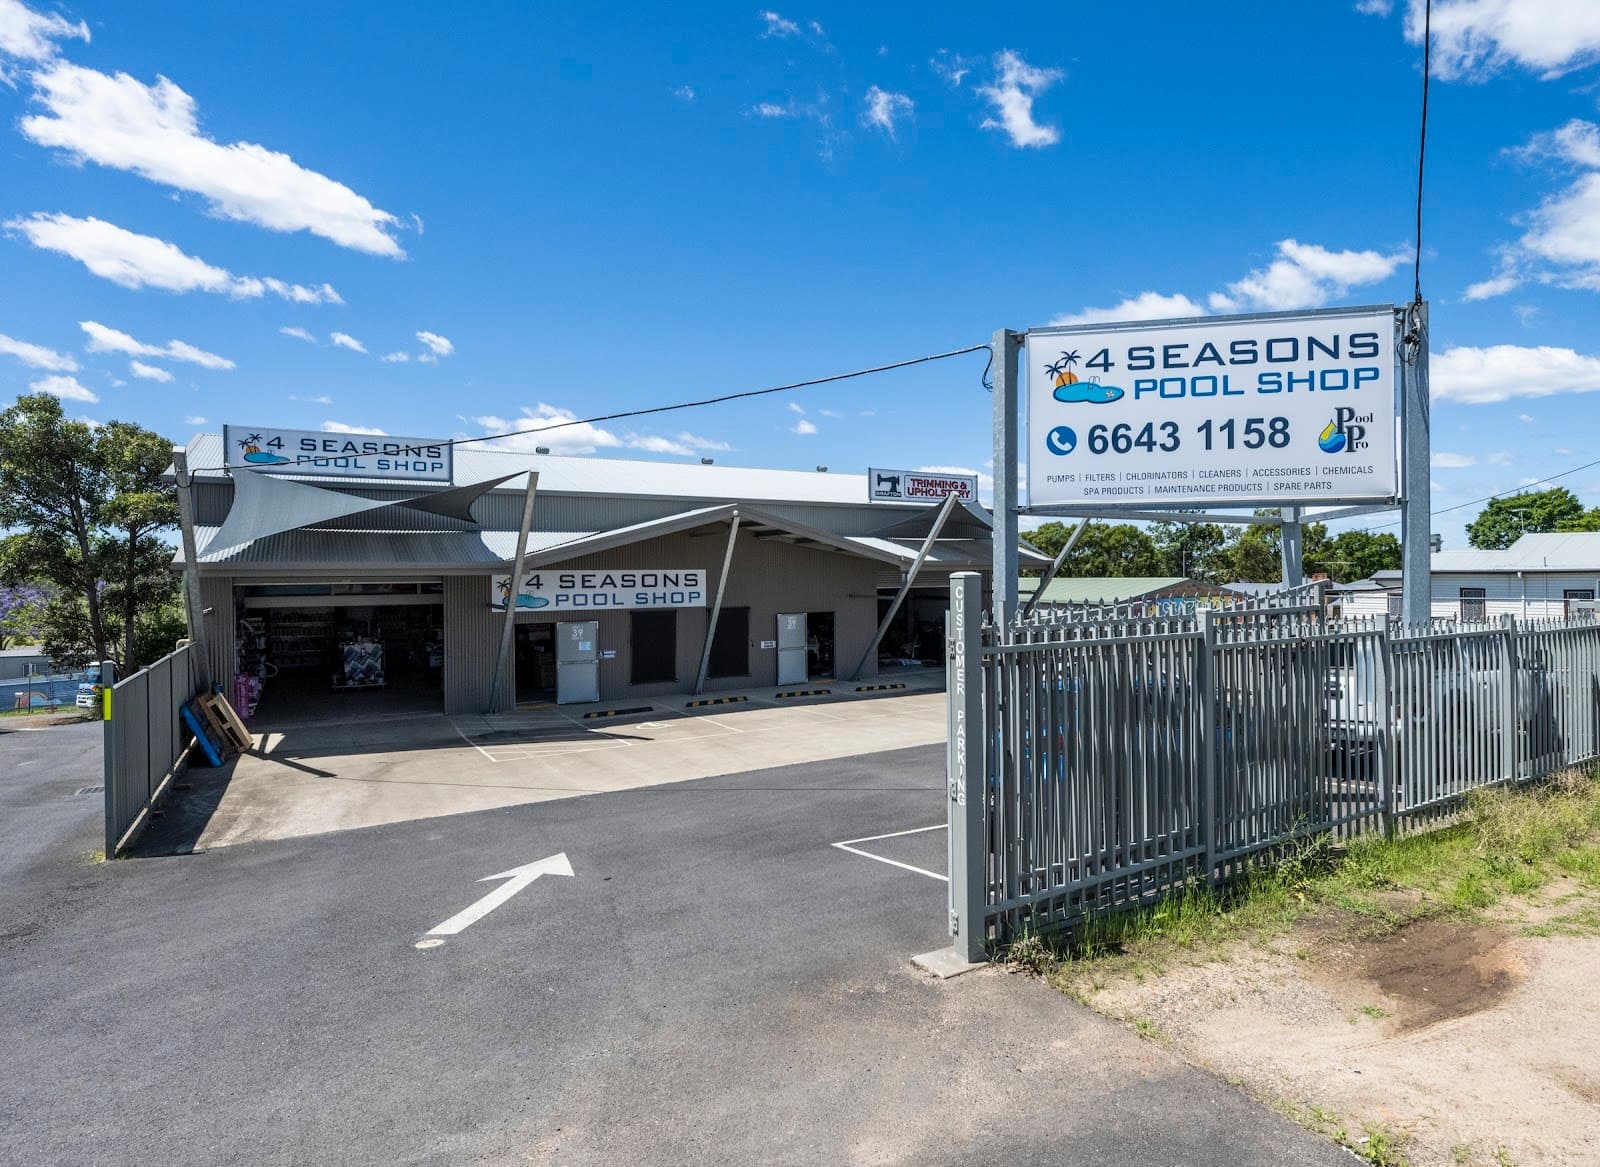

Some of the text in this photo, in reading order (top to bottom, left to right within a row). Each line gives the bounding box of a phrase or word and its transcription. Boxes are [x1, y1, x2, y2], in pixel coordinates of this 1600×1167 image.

[1085, 332, 1379, 373] 4 SEASONS
[1134, 366, 1380, 400] POOL SHOP
[1334, 407, 1373, 434] Pool
[266, 436, 441, 459] 4 SEASONS
[1087, 416, 1291, 455] 6643 1158
[1344, 425, 1369, 452] Pro
[297, 455, 443, 473] POOL SHOP
[1047, 465, 1374, 483] PUMPS FILTERS CHLORINATORS CLEANERS ACCESSORIES CHEMICALS
[911, 478, 959, 489] TRIMMING
[1083, 480, 1333, 496] SPA PRODUCTS MAINTENANCE PRODUCTS SPARE PARTS
[525, 573, 699, 590] 4 SEASONS
[555, 591, 701, 607] POOL SHOP
[956, 586, 966, 696] CUSTOMER
[957, 711, 966, 806] PARKING
